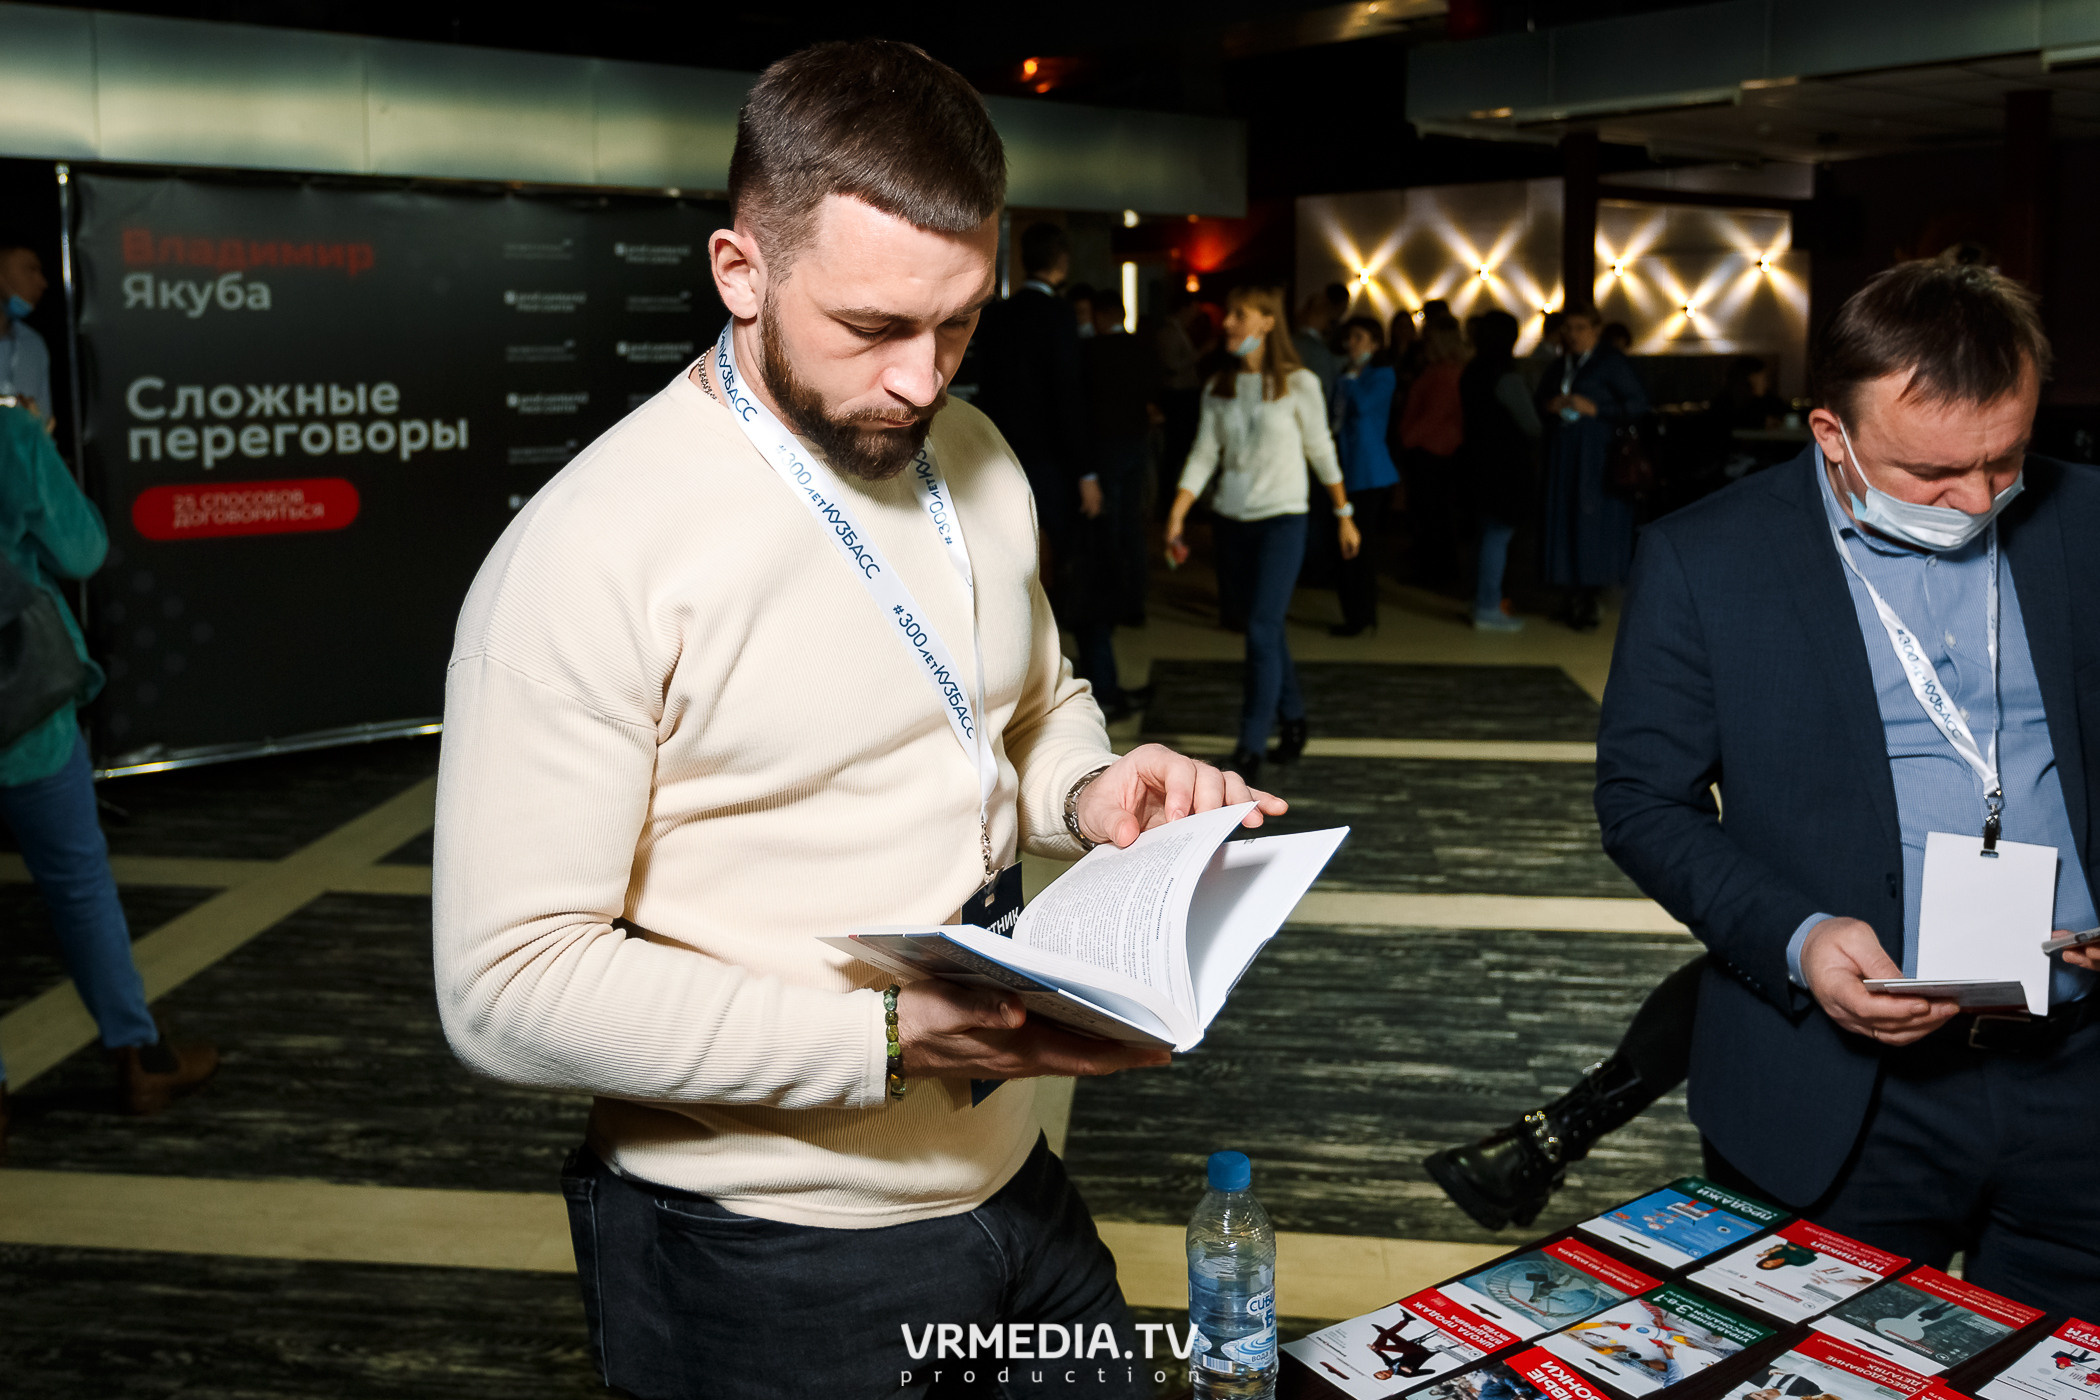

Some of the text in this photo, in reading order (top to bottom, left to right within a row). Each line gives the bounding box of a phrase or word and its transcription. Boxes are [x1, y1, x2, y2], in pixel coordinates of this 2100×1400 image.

[122, 228, 375, 277] Владимир
[122, 272, 272, 318] Якуба
[126, 376, 400, 420] Сложные
[128, 418, 469, 469] переговоры
[201, 488, 305, 508] СПОСОБОВ
[173, 503, 325, 530] ДОГОВОРИТЬСЯ
[987, 907, 1019, 934] ТНИК
[1696, 1187, 1775, 1220] ПРОДАЖИ
[1412, 1301, 1496, 1349] ШКОЛА ПРОДАЖ
[1450, 1314, 1504, 1345] ВЛАДИМИРА
[1687, 1312, 1750, 1343] УПРАВЛЕНИЕ
[1825, 1355, 1919, 1393] ОБЕСЕДОВАНИЕ
[1867, 1363, 1923, 1387] ДЕТАЛЯХ
